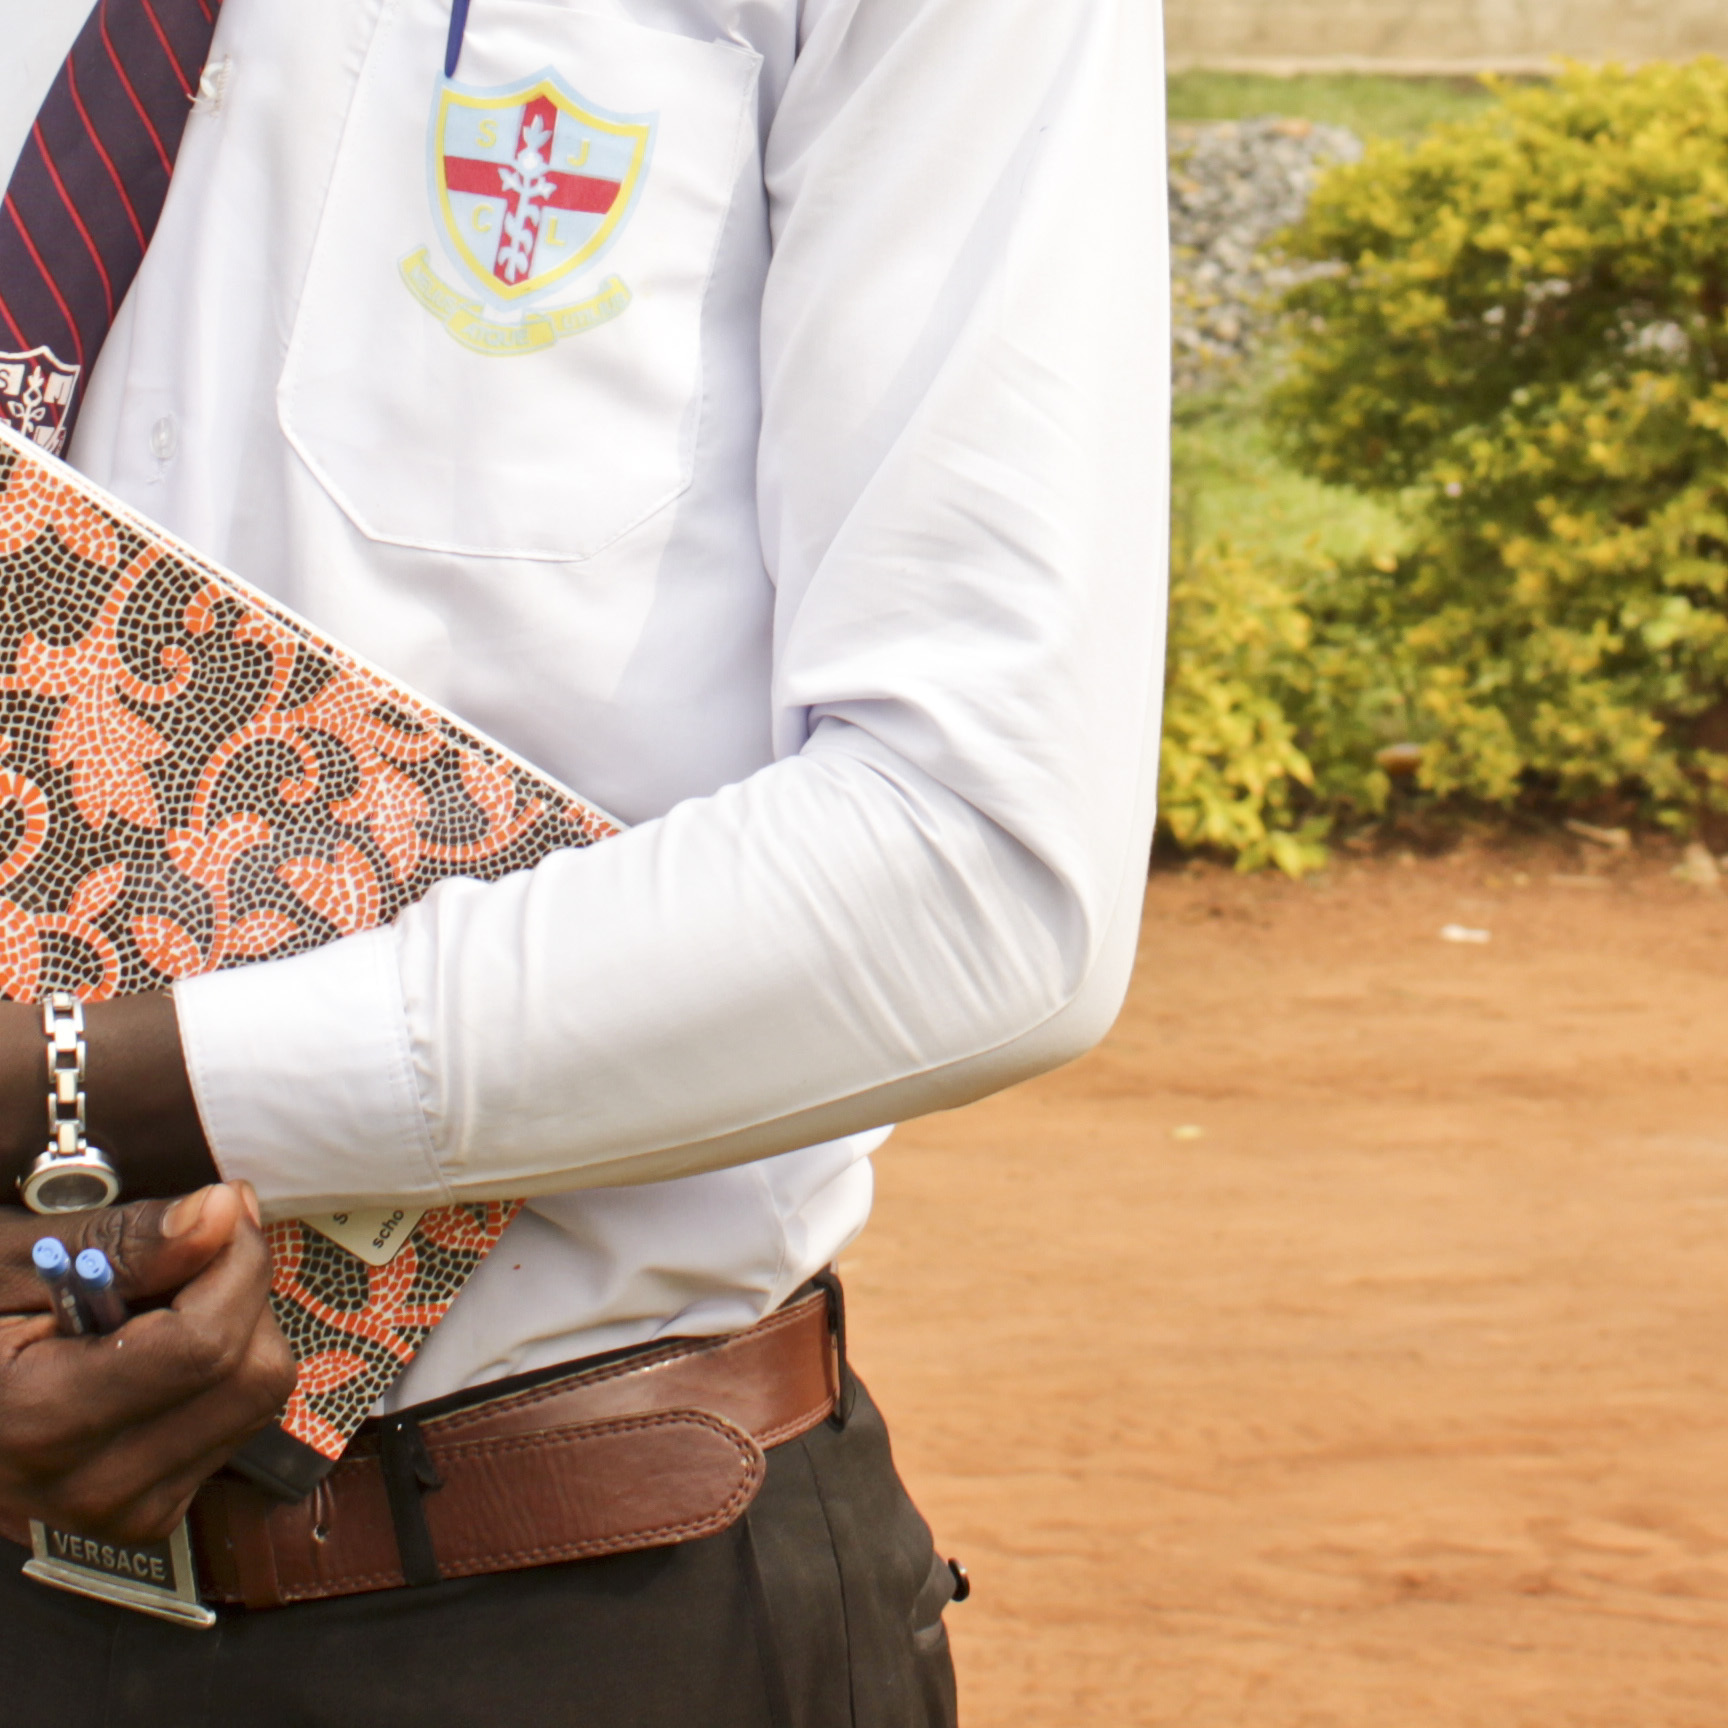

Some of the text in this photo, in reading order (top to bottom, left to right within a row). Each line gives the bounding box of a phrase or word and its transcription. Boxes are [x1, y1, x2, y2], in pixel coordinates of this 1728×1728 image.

[474, 118, 591, 168] S J
[471, 203, 566, 247] C L
[459, 320, 531, 347] ATQUE
[372, 1209, 406, 1249] scho
[53, 1529, 167, 1582] VERSACE
